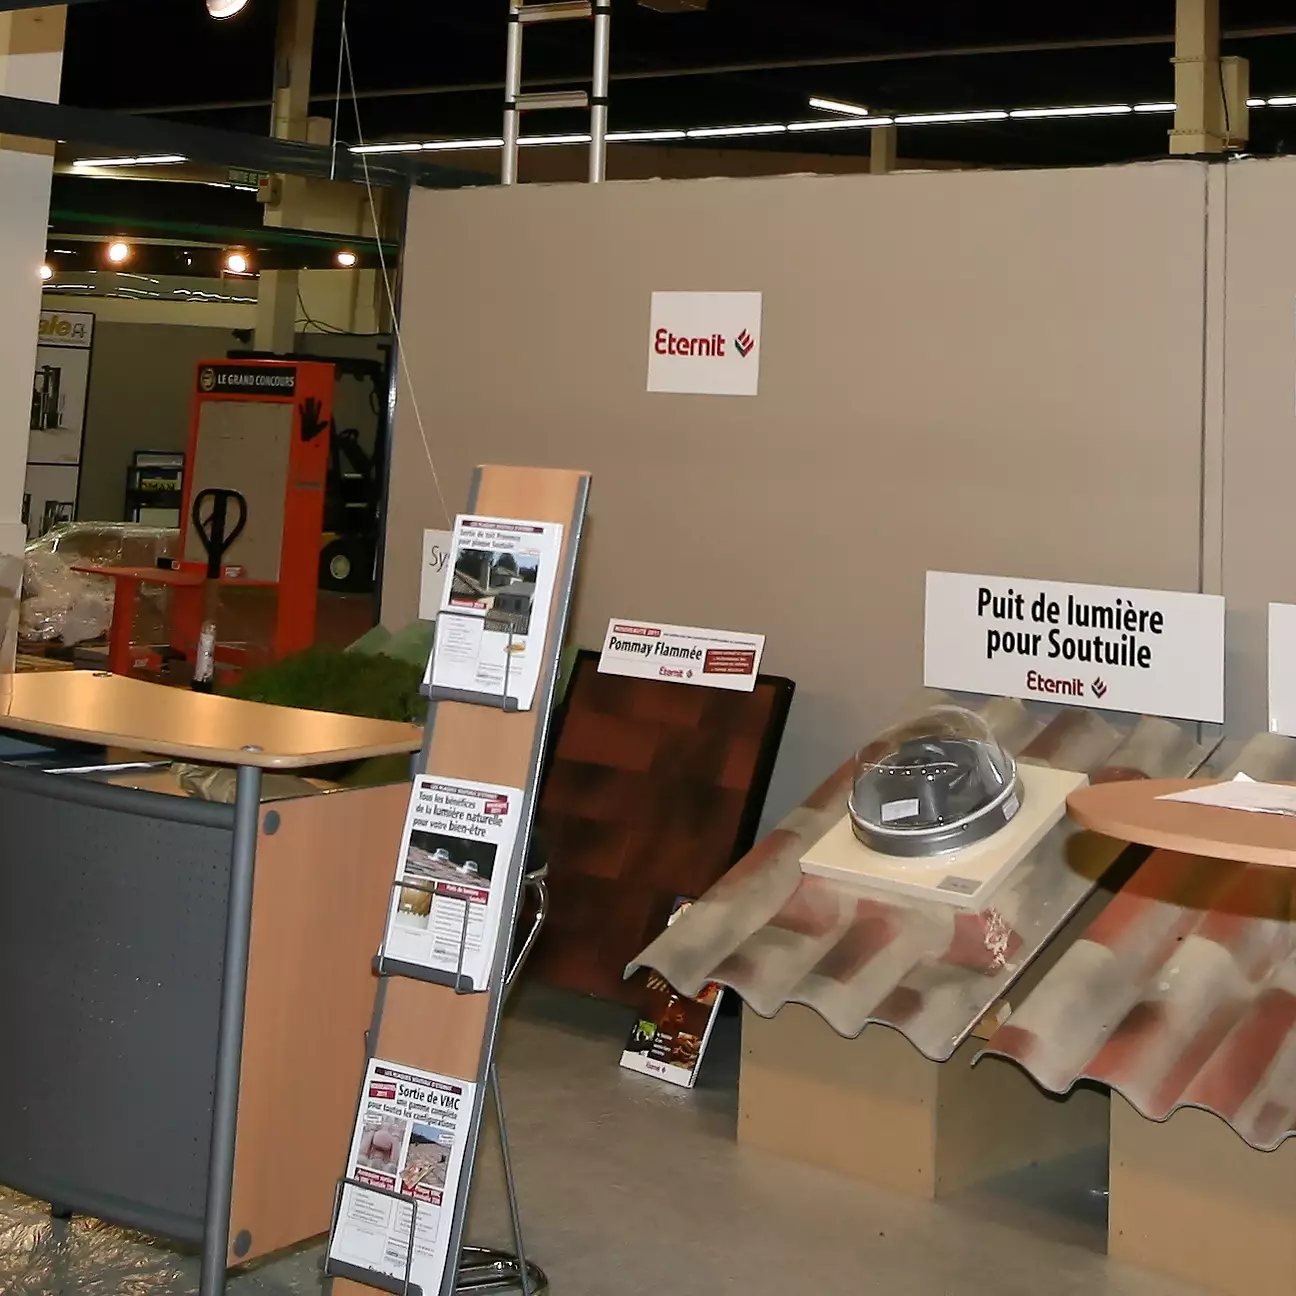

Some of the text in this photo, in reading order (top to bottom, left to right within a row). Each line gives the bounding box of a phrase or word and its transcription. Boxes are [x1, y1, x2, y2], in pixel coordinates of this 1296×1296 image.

[654, 328, 726, 358] Eternit
[217, 374, 226, 384] LE
[977, 587, 1164, 635] Puit de lumière
[609, 636, 653, 658] Pommay
[654, 641, 702, 661] Flammée
[986, 628, 1152, 669] pour Soutuile
[1026, 670, 1084, 697] Eternit
[398, 1084, 425, 1102] Sortie
[426, 1090, 438, 1105] de
[440, 1094, 460, 1111] VMC
